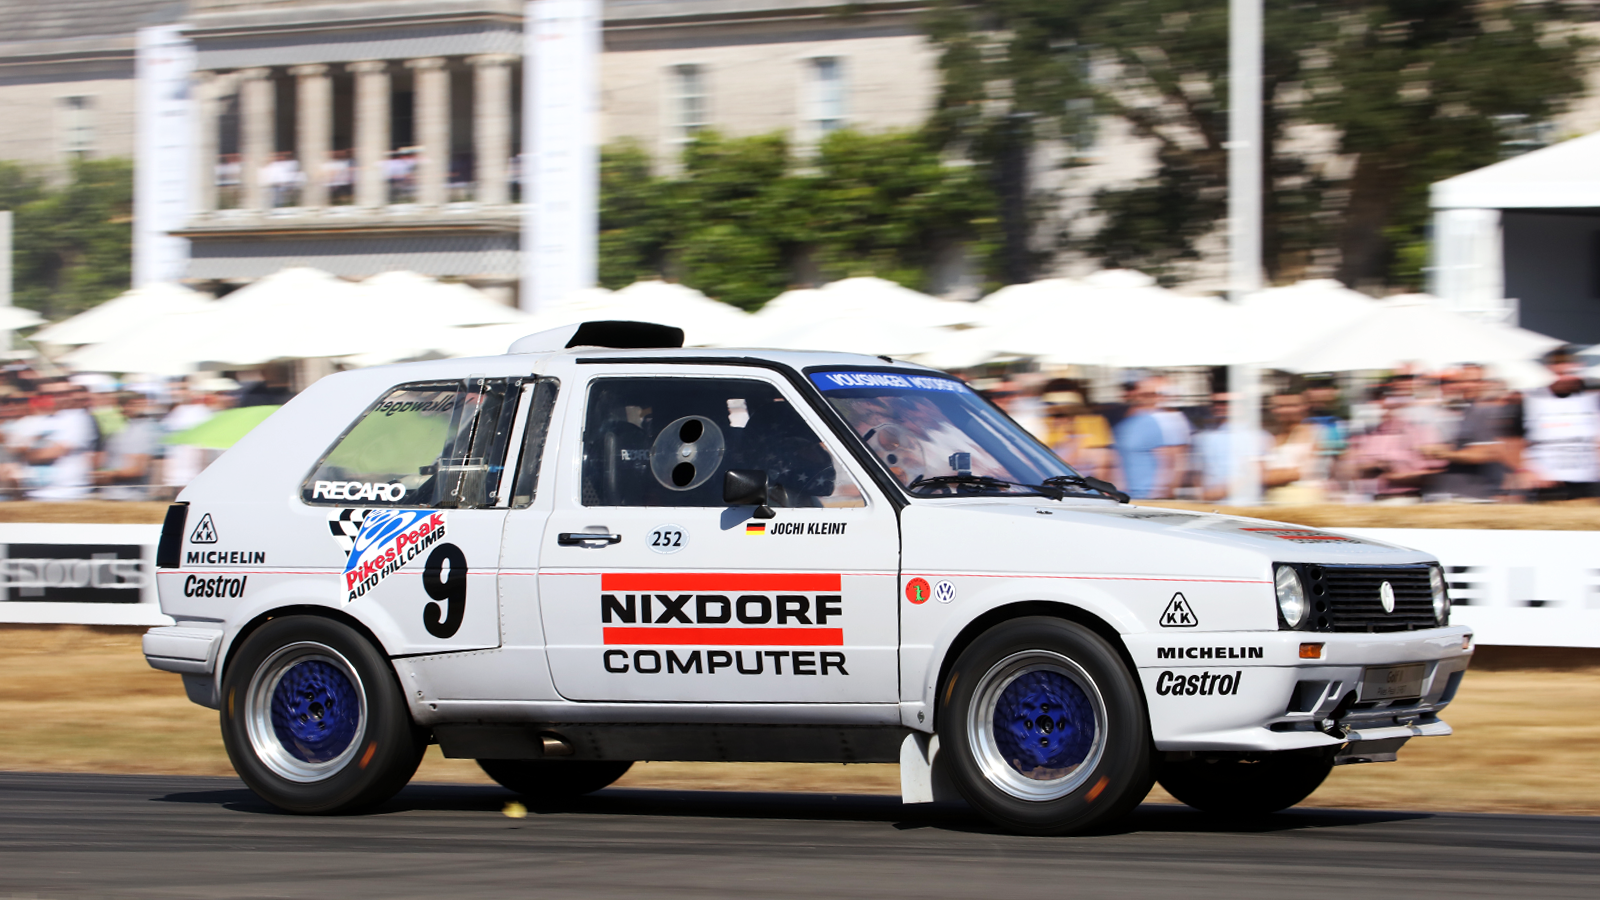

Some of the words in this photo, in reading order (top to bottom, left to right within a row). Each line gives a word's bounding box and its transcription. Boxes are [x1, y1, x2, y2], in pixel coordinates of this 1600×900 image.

[825, 374, 913, 388] VOLKSWAGEN
[312, 480, 406, 501] RECARO
[651, 530, 682, 547] 252
[770, 522, 805, 535] JOCHI
[807, 522, 847, 535] KLEINT
[186, 551, 265, 564] MICHELIN
[346, 547, 396, 591] Pikes
[396, 513, 445, 556] Peak
[348, 573, 379, 602] AUTO
[381, 555, 407, 579] HILL
[407, 525, 445, 560] CLIMB
[184, 574, 247, 598] Castrol
[422, 542, 468, 639] 9
[601, 594, 843, 625] NIXDORF
[603, 649, 849, 676] COMPUTER
[1157, 647, 1263, 659] MICHELIN
[1156, 670, 1242, 696] Castrol
